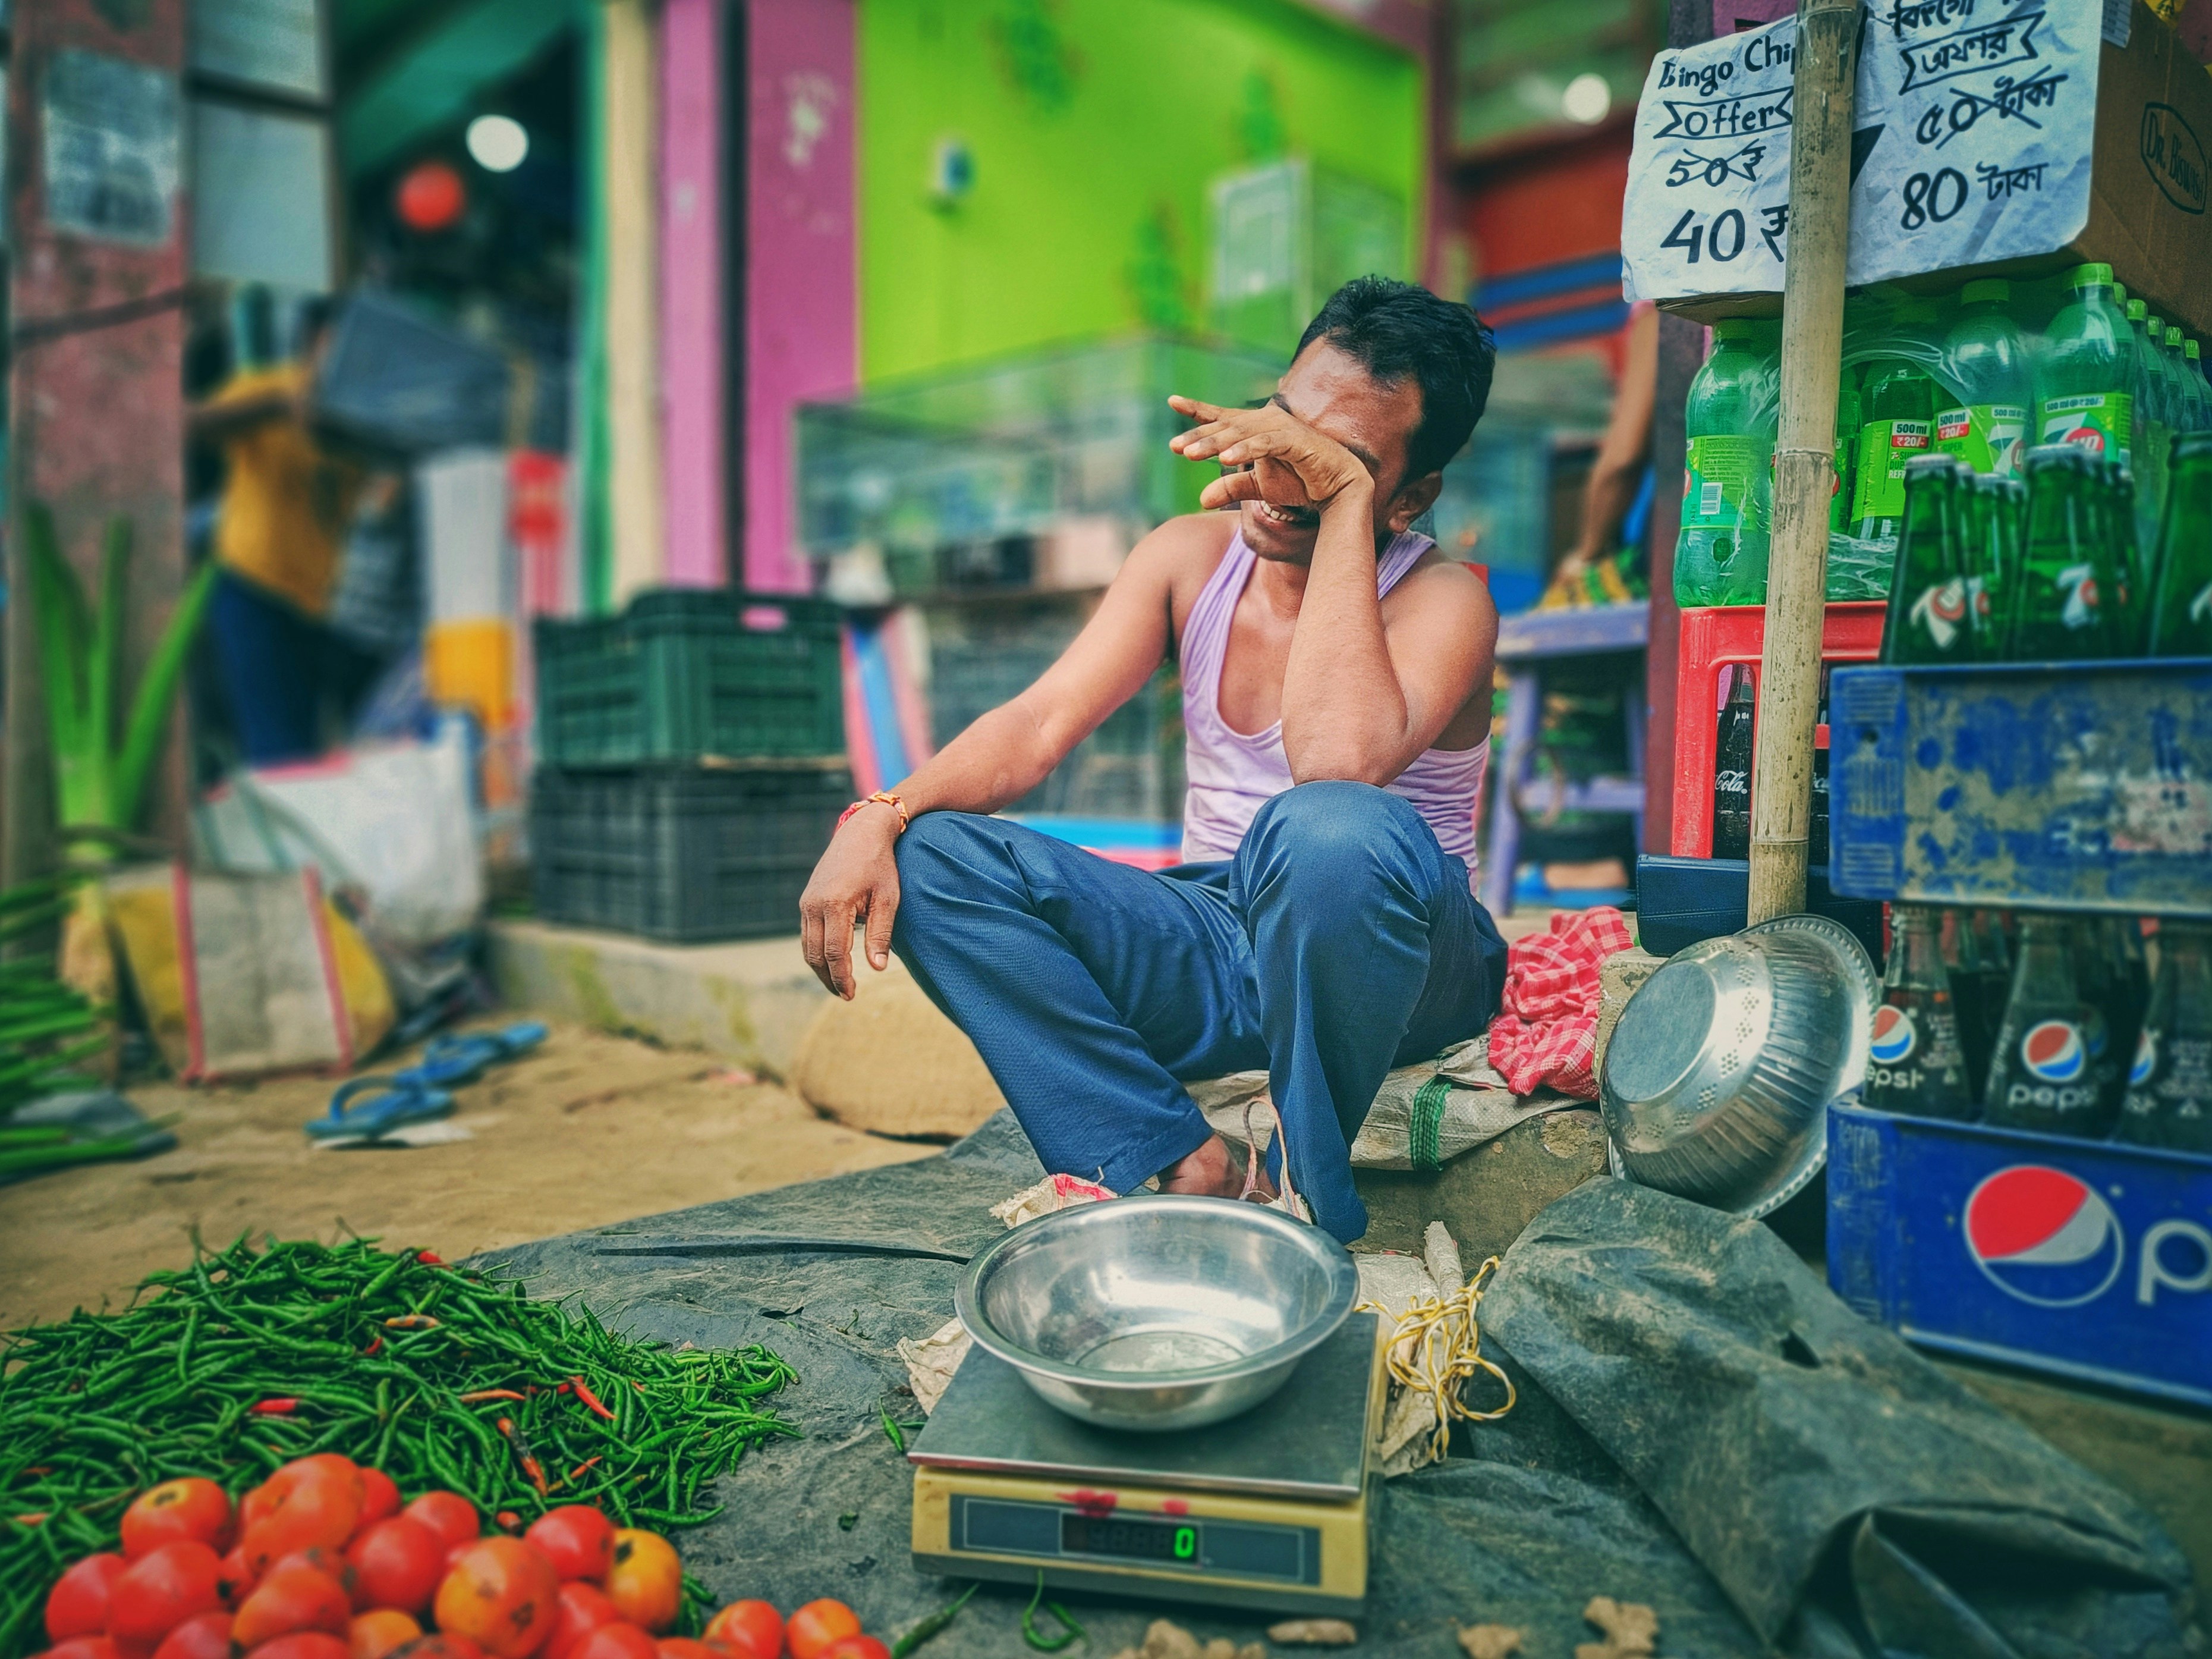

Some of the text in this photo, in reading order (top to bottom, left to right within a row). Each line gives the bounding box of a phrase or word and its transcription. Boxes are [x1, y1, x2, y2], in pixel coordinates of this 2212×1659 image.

[1658, 60, 1733, 96] Bingo
[1684, 101, 1775, 136] Offer
[1975, 161, 2050, 200] টাকা
[1896, 423, 1927, 435] 500 ml
[1940, 412, 1966, 426] 500 ml
[1896, 436, 1925, 447] ₹20/-
[1889, 460, 1905, 470] DUP
[1899, 451, 1918, 460] SUP
[1714, 769, 1749, 792] Cola
[1867, 1064, 1918, 1090] epsi
[2008, 1082, 2097, 1114] peps
[1174, 1527, 1195, 1558] 0
